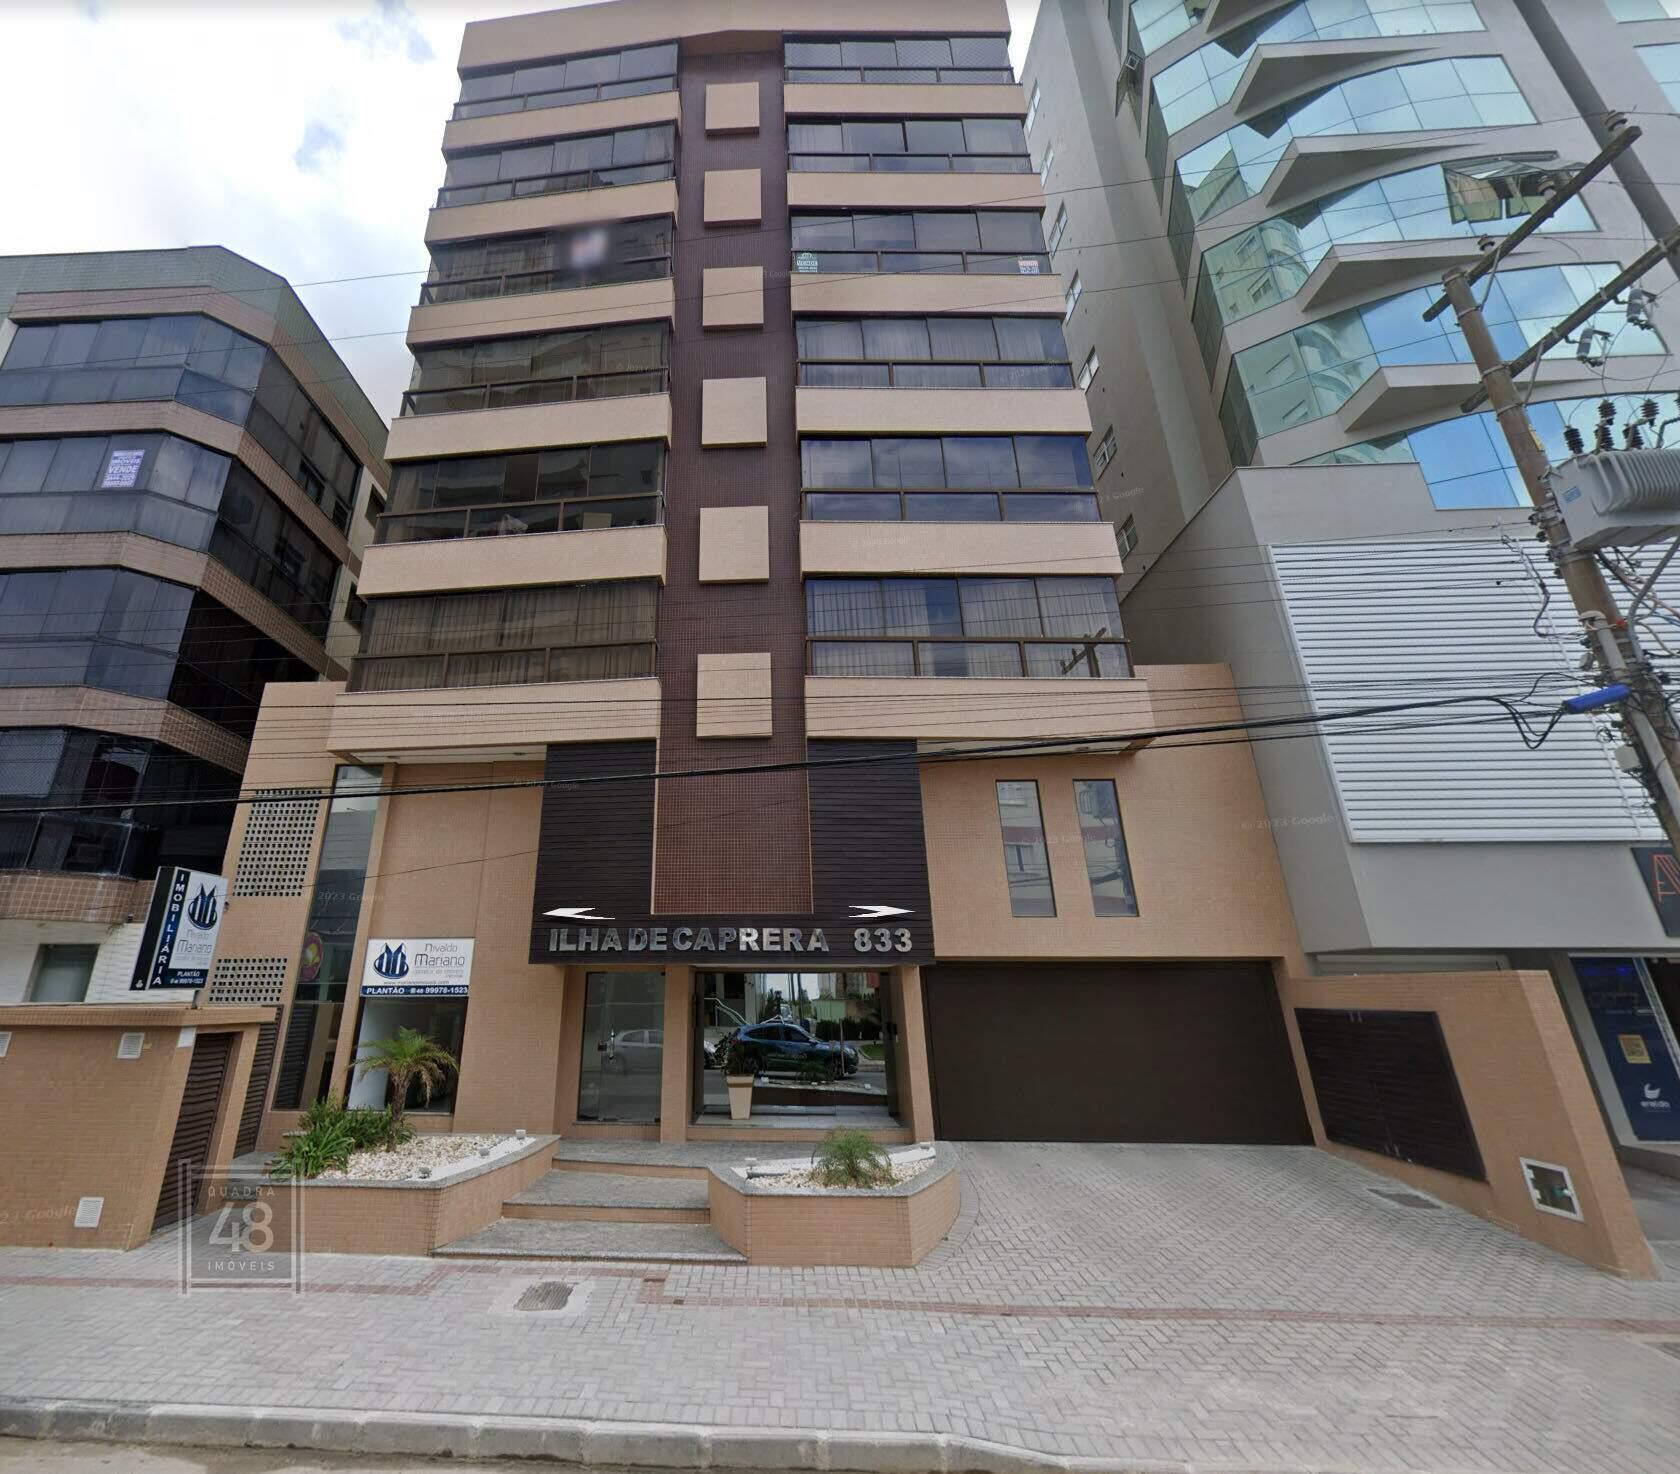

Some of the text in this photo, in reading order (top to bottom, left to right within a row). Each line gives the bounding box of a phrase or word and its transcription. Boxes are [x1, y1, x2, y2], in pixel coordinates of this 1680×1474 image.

[152, 873, 185, 985] IMOBILIÁRIA
[853, 927, 913, 952] 833
[366, 986, 405, 995] PLANTÃO
[425, 986, 468, 994] 99978-1523
